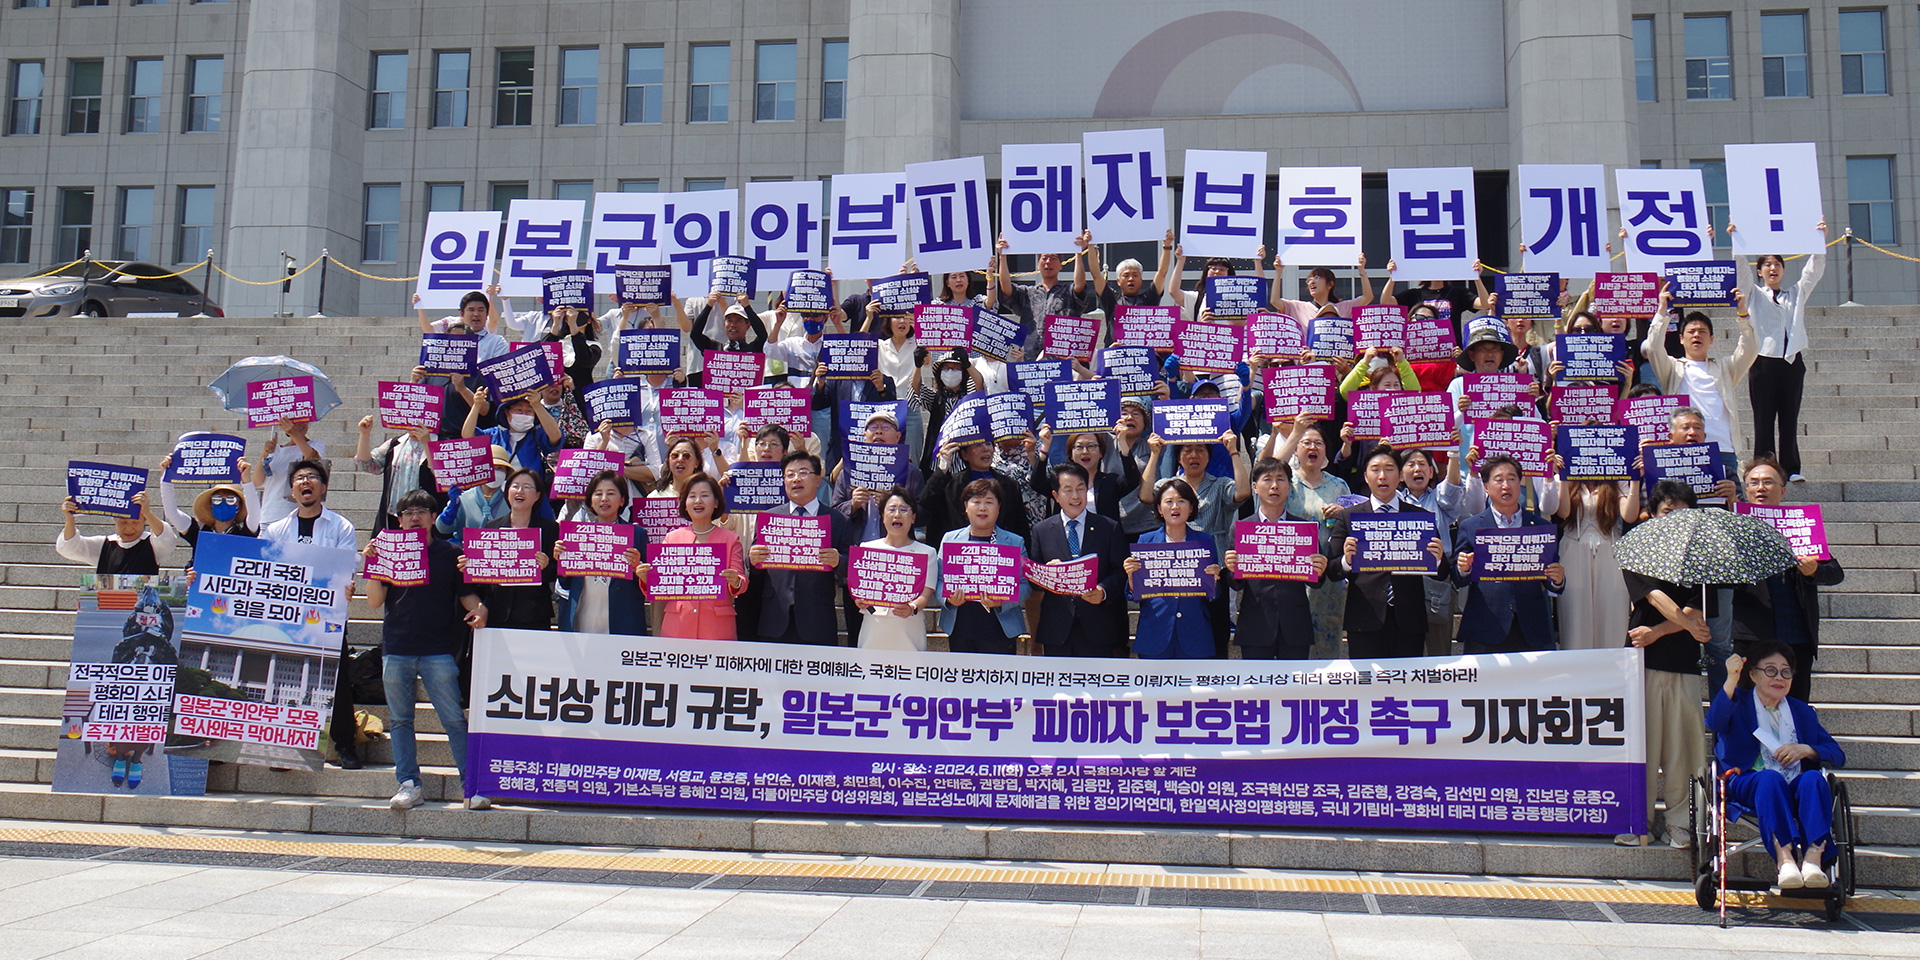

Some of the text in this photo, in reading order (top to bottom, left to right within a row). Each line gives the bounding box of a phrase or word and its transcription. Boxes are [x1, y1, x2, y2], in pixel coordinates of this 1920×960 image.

[1008, 165, 1072, 232] 해
[1091, 151, 1162, 221] 자
[1765, 167, 1784, 232] !
[914, 180, 982, 254] 피
[1187, 171, 1256, 236] 보
[1284, 186, 1355, 245] 호
[750, 203, 818, 269] 안
[1399, 190, 1466, 258] 법
[1529, 187, 1600, 257] 개
[1627, 190, 1702, 256] 정
[428, 230, 490, 290] 일
[509, 219, 573, 278] 본
[595, 214, 658, 275] 군
[1570, 466, 1627, 475] 방치하지 마라!
[1571, 456, 1626, 465] 국회는 더이상
[78, 478, 132, 490] 평화의 소녀상
[652, 556, 720, 565] 소녀상을 모욕하는
[660, 546, 712, 556] 시민들이 세운
[947, 555, 1014, 567] 시민과 국회의원의
[961, 546, 1001, 556] 22대 국회,
[234, 560, 308, 585] 22대 국회,
[659, 576, 713, 585] 제지할 수 있게
[963, 565, 998, 574] 힘을 모아
[204, 576, 334, 606] 시민과 국회의원의
[650, 585, 721, 594] 보호법을 개정하라!
[233, 600, 301, 622] 힘을 모아
[74, 664, 148, 681] 전국적으로
[620, 650, 1478, 688] 일본군'위안부' 피해자에 대한 명예훼손, 국회는 더이상 방치하지 마라! 전국적으로 이뤄지는 평화의 소녀상 테러 행위를 즉각 처벌하라!
[94, 684, 172, 702] 평화의 소녀
[99, 704, 130, 721] 테러
[180, 695, 322, 730] 일본군'위안부' 모욕,
[486, 674, 600, 724] 소녀상
[604, 680, 678, 728] 테러
[686, 684, 771, 740] 규탄,
[1032, 698, 1149, 744] 피해자
[1154, 698, 1270, 745] 보호법
[1281, 699, 1360, 745] 개정
[1369, 697, 1452, 745] 촉구
[1461, 696, 1625, 746] 기자회견
[86, 724, 166, 742] 즉각 처벌하
[180, 717, 316, 748] 역사왜곡 막아내자!
[489, 759, 1620, 807] 공동주최: 더불어민주당 이재명, 서영교, 윤호중, 남인순, 이재정, 최민희, 이수진, 안태준, 권향엽, 박지혜, 김용만, 김준혁, 백승아 의원, 조국혁신당 조국, 김준형, 강경숙, 김선민 의원, 진보당 윤종오,
[871, 762, 895, 774] 일시
[934, 764, 1024, 777] 2024.6.11(화)
[1026, 765, 1057, 778] 오후
[1059, 766, 1080, 777] 2시
[1083, 766, 1150, 777] 국회의사당
[1153, 766, 1167, 777] 앞
[1170, 766, 1197, 778] 계단
[498, 776, 539, 793] 정혜경,
[542, 780, 579, 794] 전종덕
[582, 782, 611, 796] 의원,
[614, 784, 676, 798] 기본소득당
[679, 786, 717, 799] 용혜인
[720, 787, 748, 802] 의원,
[752, 787, 829, 804] 더불어민주당
[832, 790, 898, 807] 여성위원회,
[902, 792, 993, 808] 일본군성노예제
[995, 794, 1061, 810] 문제해결을
[1064, 796, 1091, 810] 위한
[1094, 797, 1177, 813] 정의기억연대,
[1180, 798, 1318, 817] 한일역사정의평화행동,
[1322, 802, 1350, 816] 국내
[1448, 806, 1477, 820] 테러
[1480, 806, 1508, 820] 대응
[1511, 807, 1608, 824] 공동행동(가칭)
